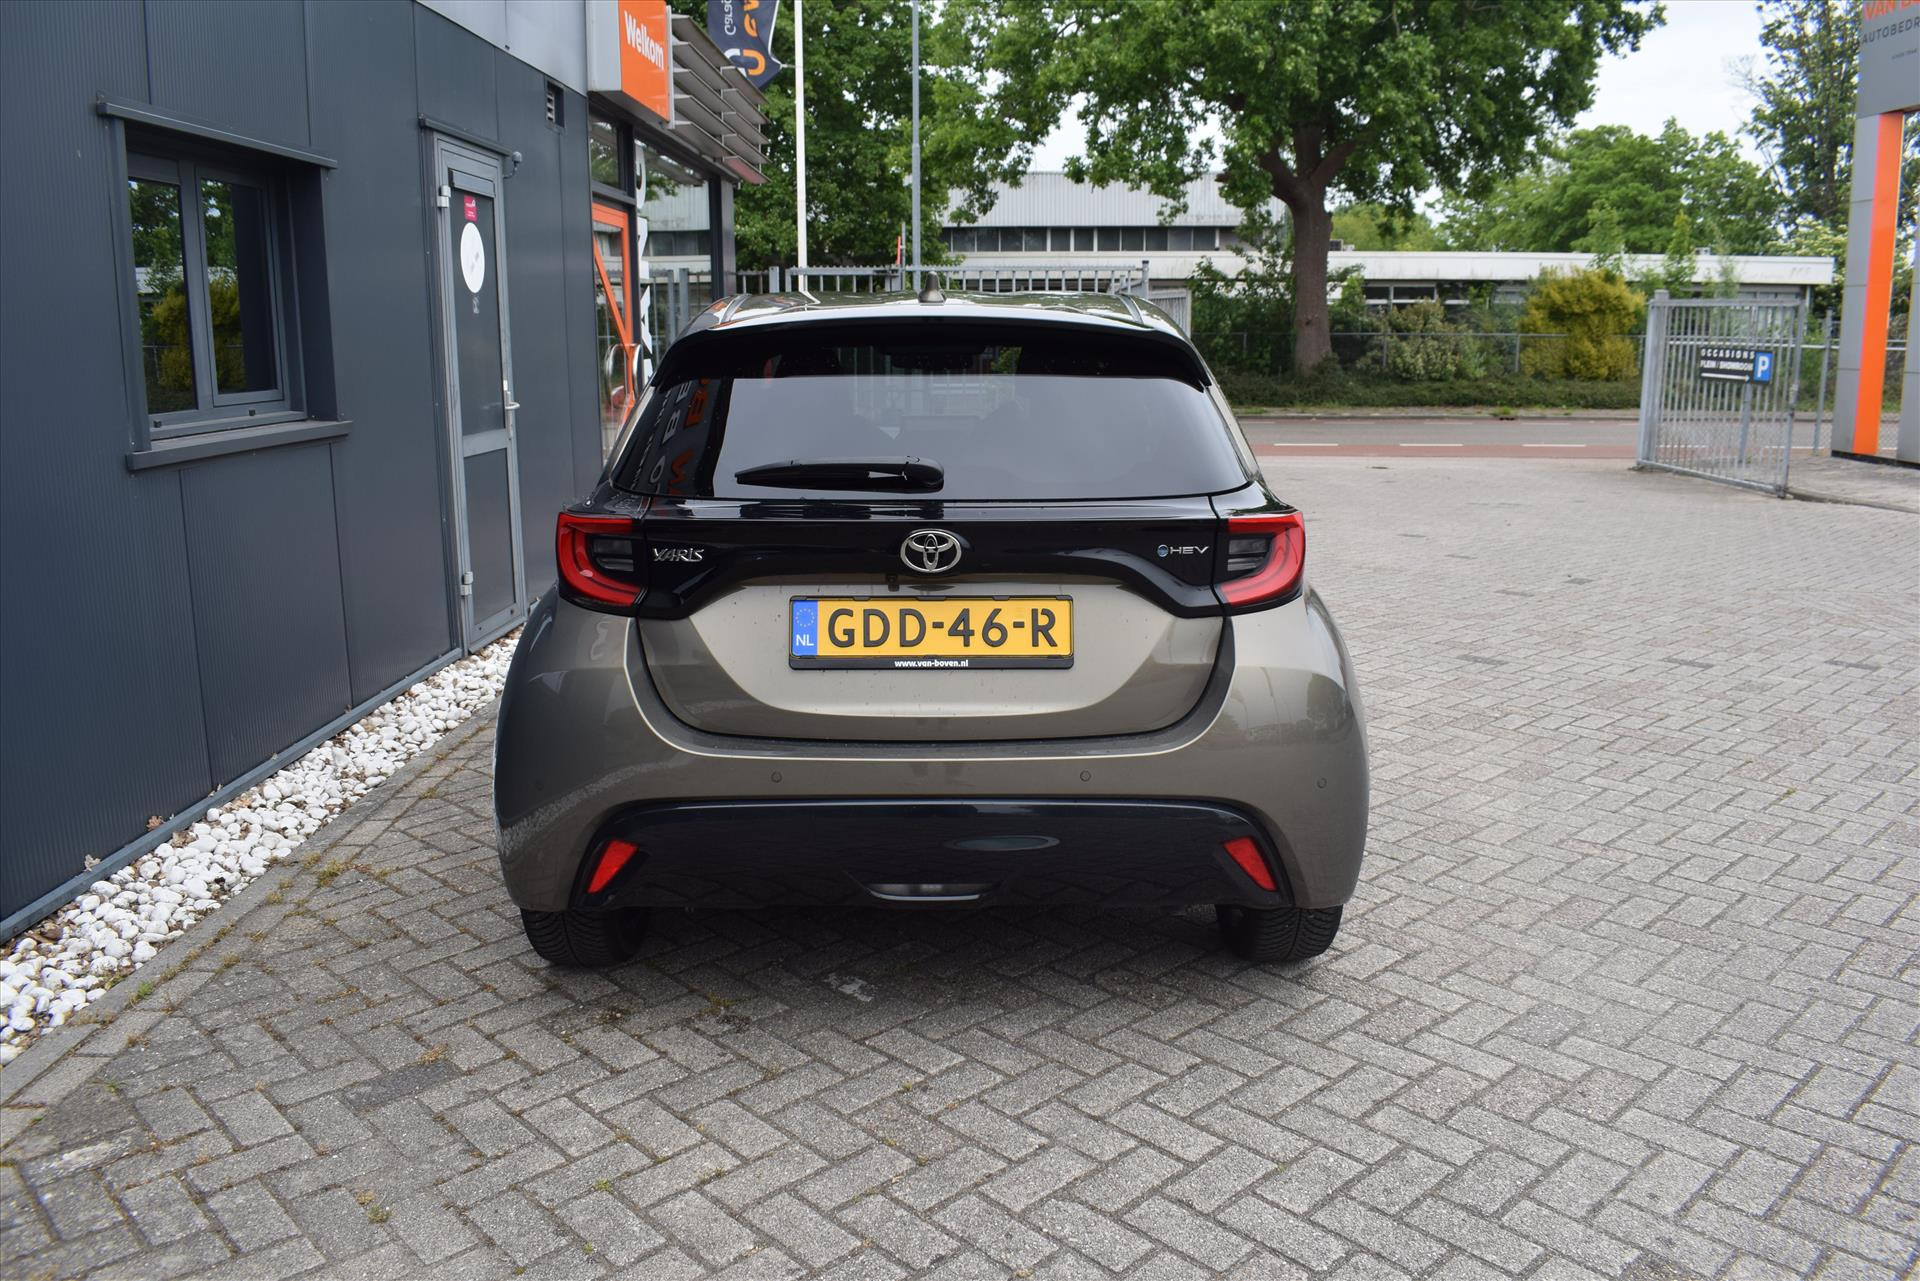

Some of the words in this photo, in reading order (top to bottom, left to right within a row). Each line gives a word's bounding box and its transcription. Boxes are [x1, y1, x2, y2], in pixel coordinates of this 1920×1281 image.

[623, 10, 665, 71] Welkom
[1701, 348, 1755, 360] OCCASIONS
[1757, 355, 1769, 377] P
[652, 548, 705, 562] YARIS
[1170, 546, 1209, 555] HEV
[828, 607, 1058, 648] GDD-46-R
[795, 634, 814, 646] NL
[894, 659, 969, 668] www.van-boven.nl
